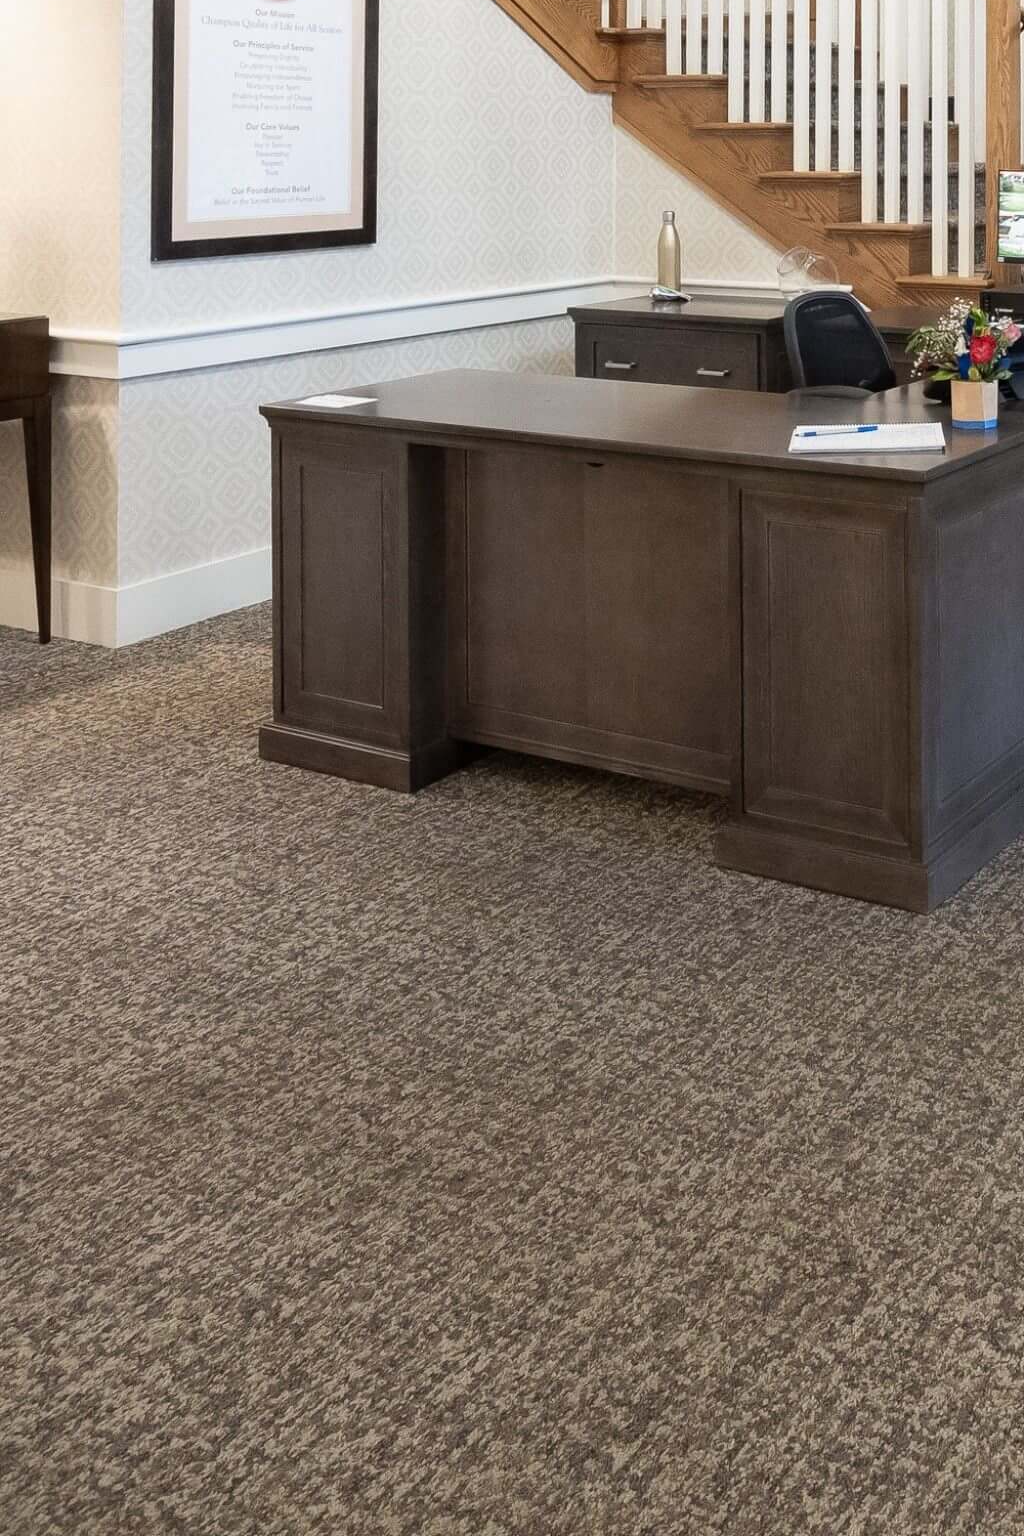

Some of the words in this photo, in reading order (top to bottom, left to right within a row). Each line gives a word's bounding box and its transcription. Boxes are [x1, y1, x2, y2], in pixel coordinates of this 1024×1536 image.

[255, 8, 268, 17] Our
[233, 39, 247, 48] Our
[248, 40, 280, 51] Principles
[245, 122, 259, 131] Our
[231, 186, 244, 195] Our
[246, 185, 290, 195] Foundational
[292, 184, 311, 193] Belief
